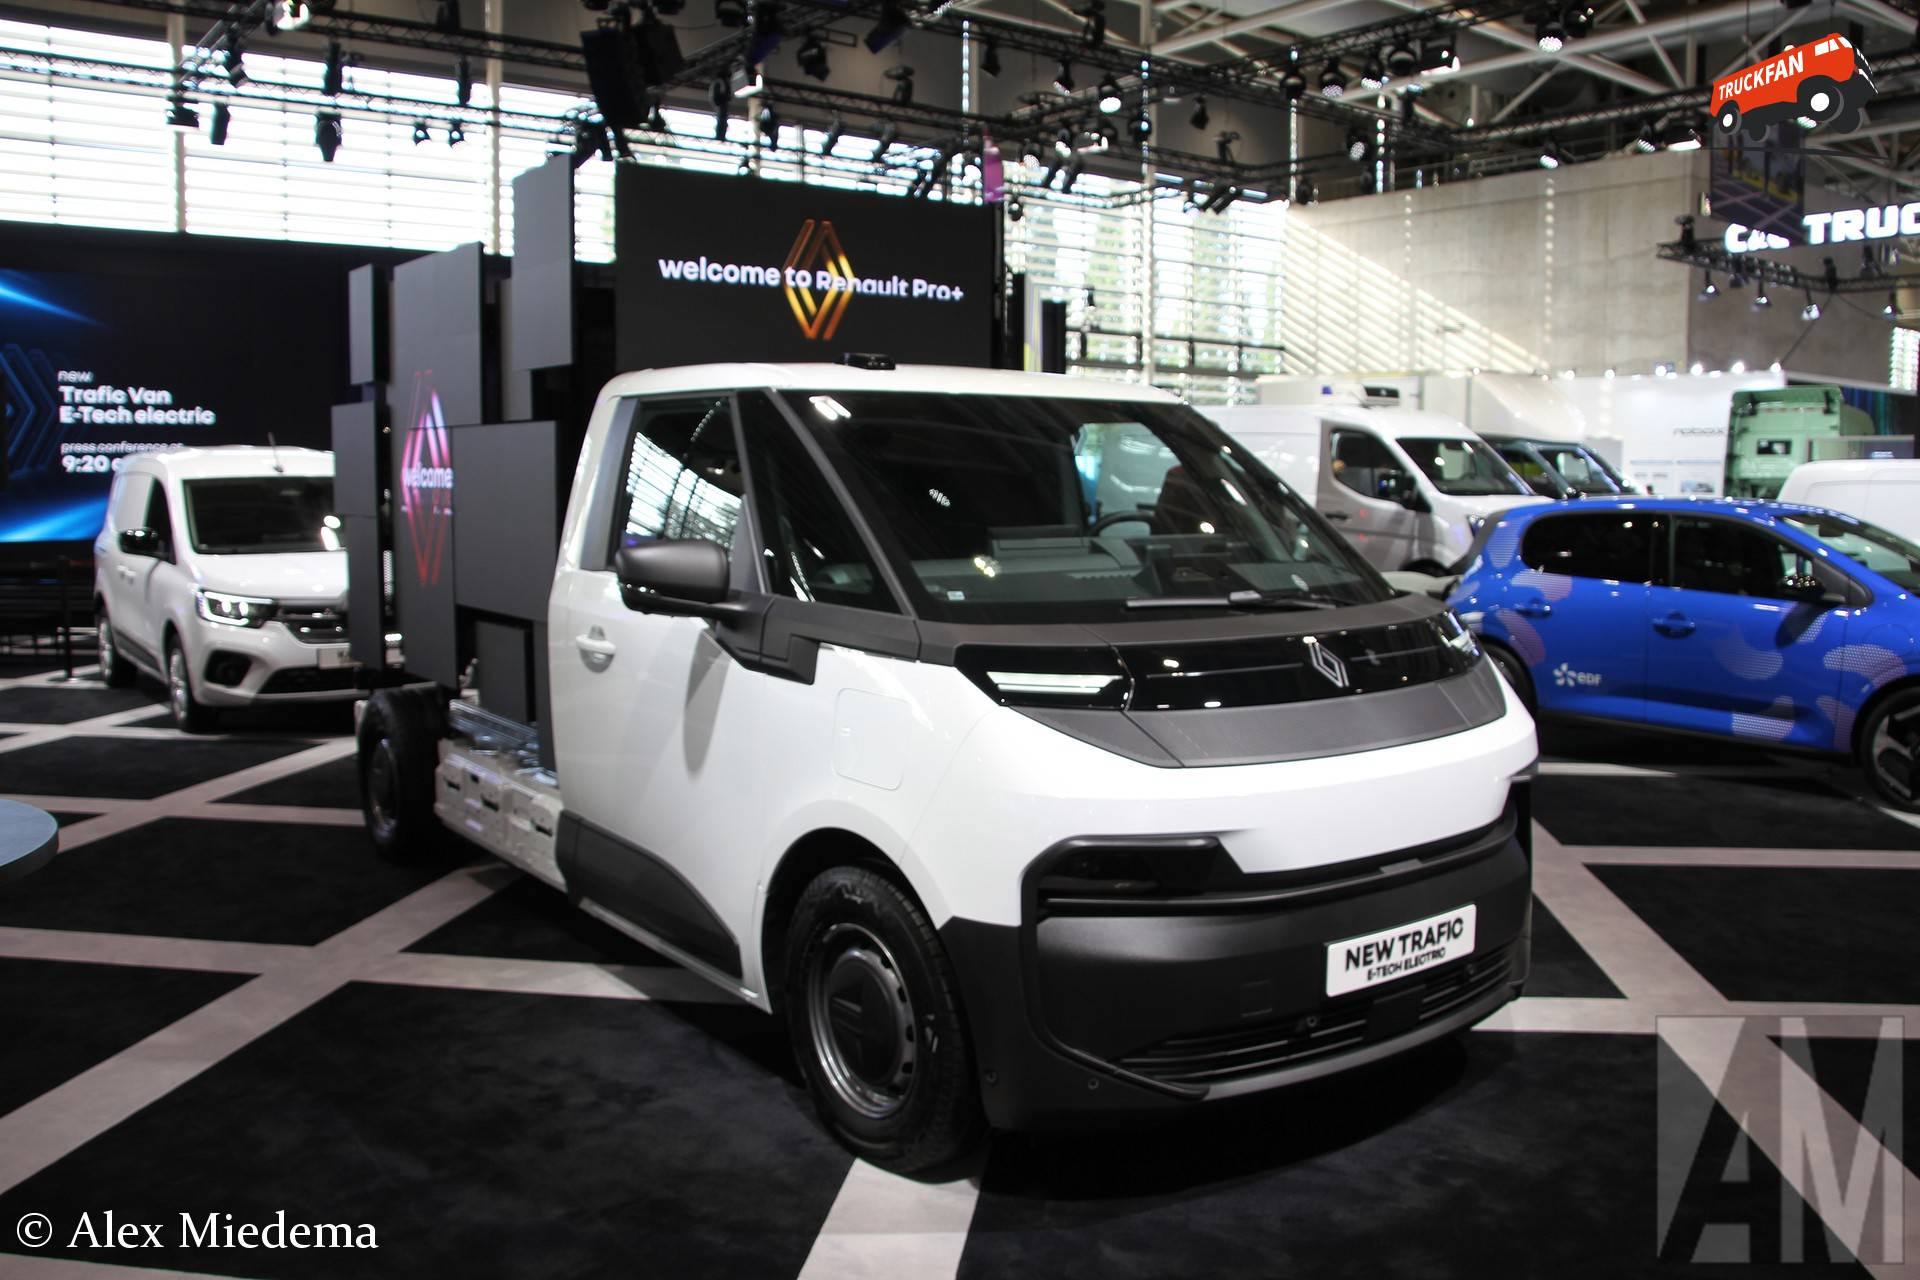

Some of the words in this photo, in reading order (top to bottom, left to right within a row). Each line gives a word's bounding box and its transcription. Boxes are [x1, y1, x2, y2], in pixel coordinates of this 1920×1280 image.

[658, 256, 781, 287] welcome
[784, 267, 812, 288] to
[815, 270, 908, 297] Renault
[912, 278, 964, 301] Pro+
[58, 370, 92, 382] new
[59, 385, 127, 404] Trafic
[128, 387, 172, 405] Van
[59, 405, 133, 424] E-Tech
[134, 406, 216, 425] electric
[61, 442, 97, 455] press
[62, 455, 110, 473] 9:20
[1345, 937, 1396, 971] NEW
[1399, 917, 1464, 956] TRAFIC
[1367, 962, 1402, 981] E-TECH
[1404, 947, 1446, 971] ELECTRIC
